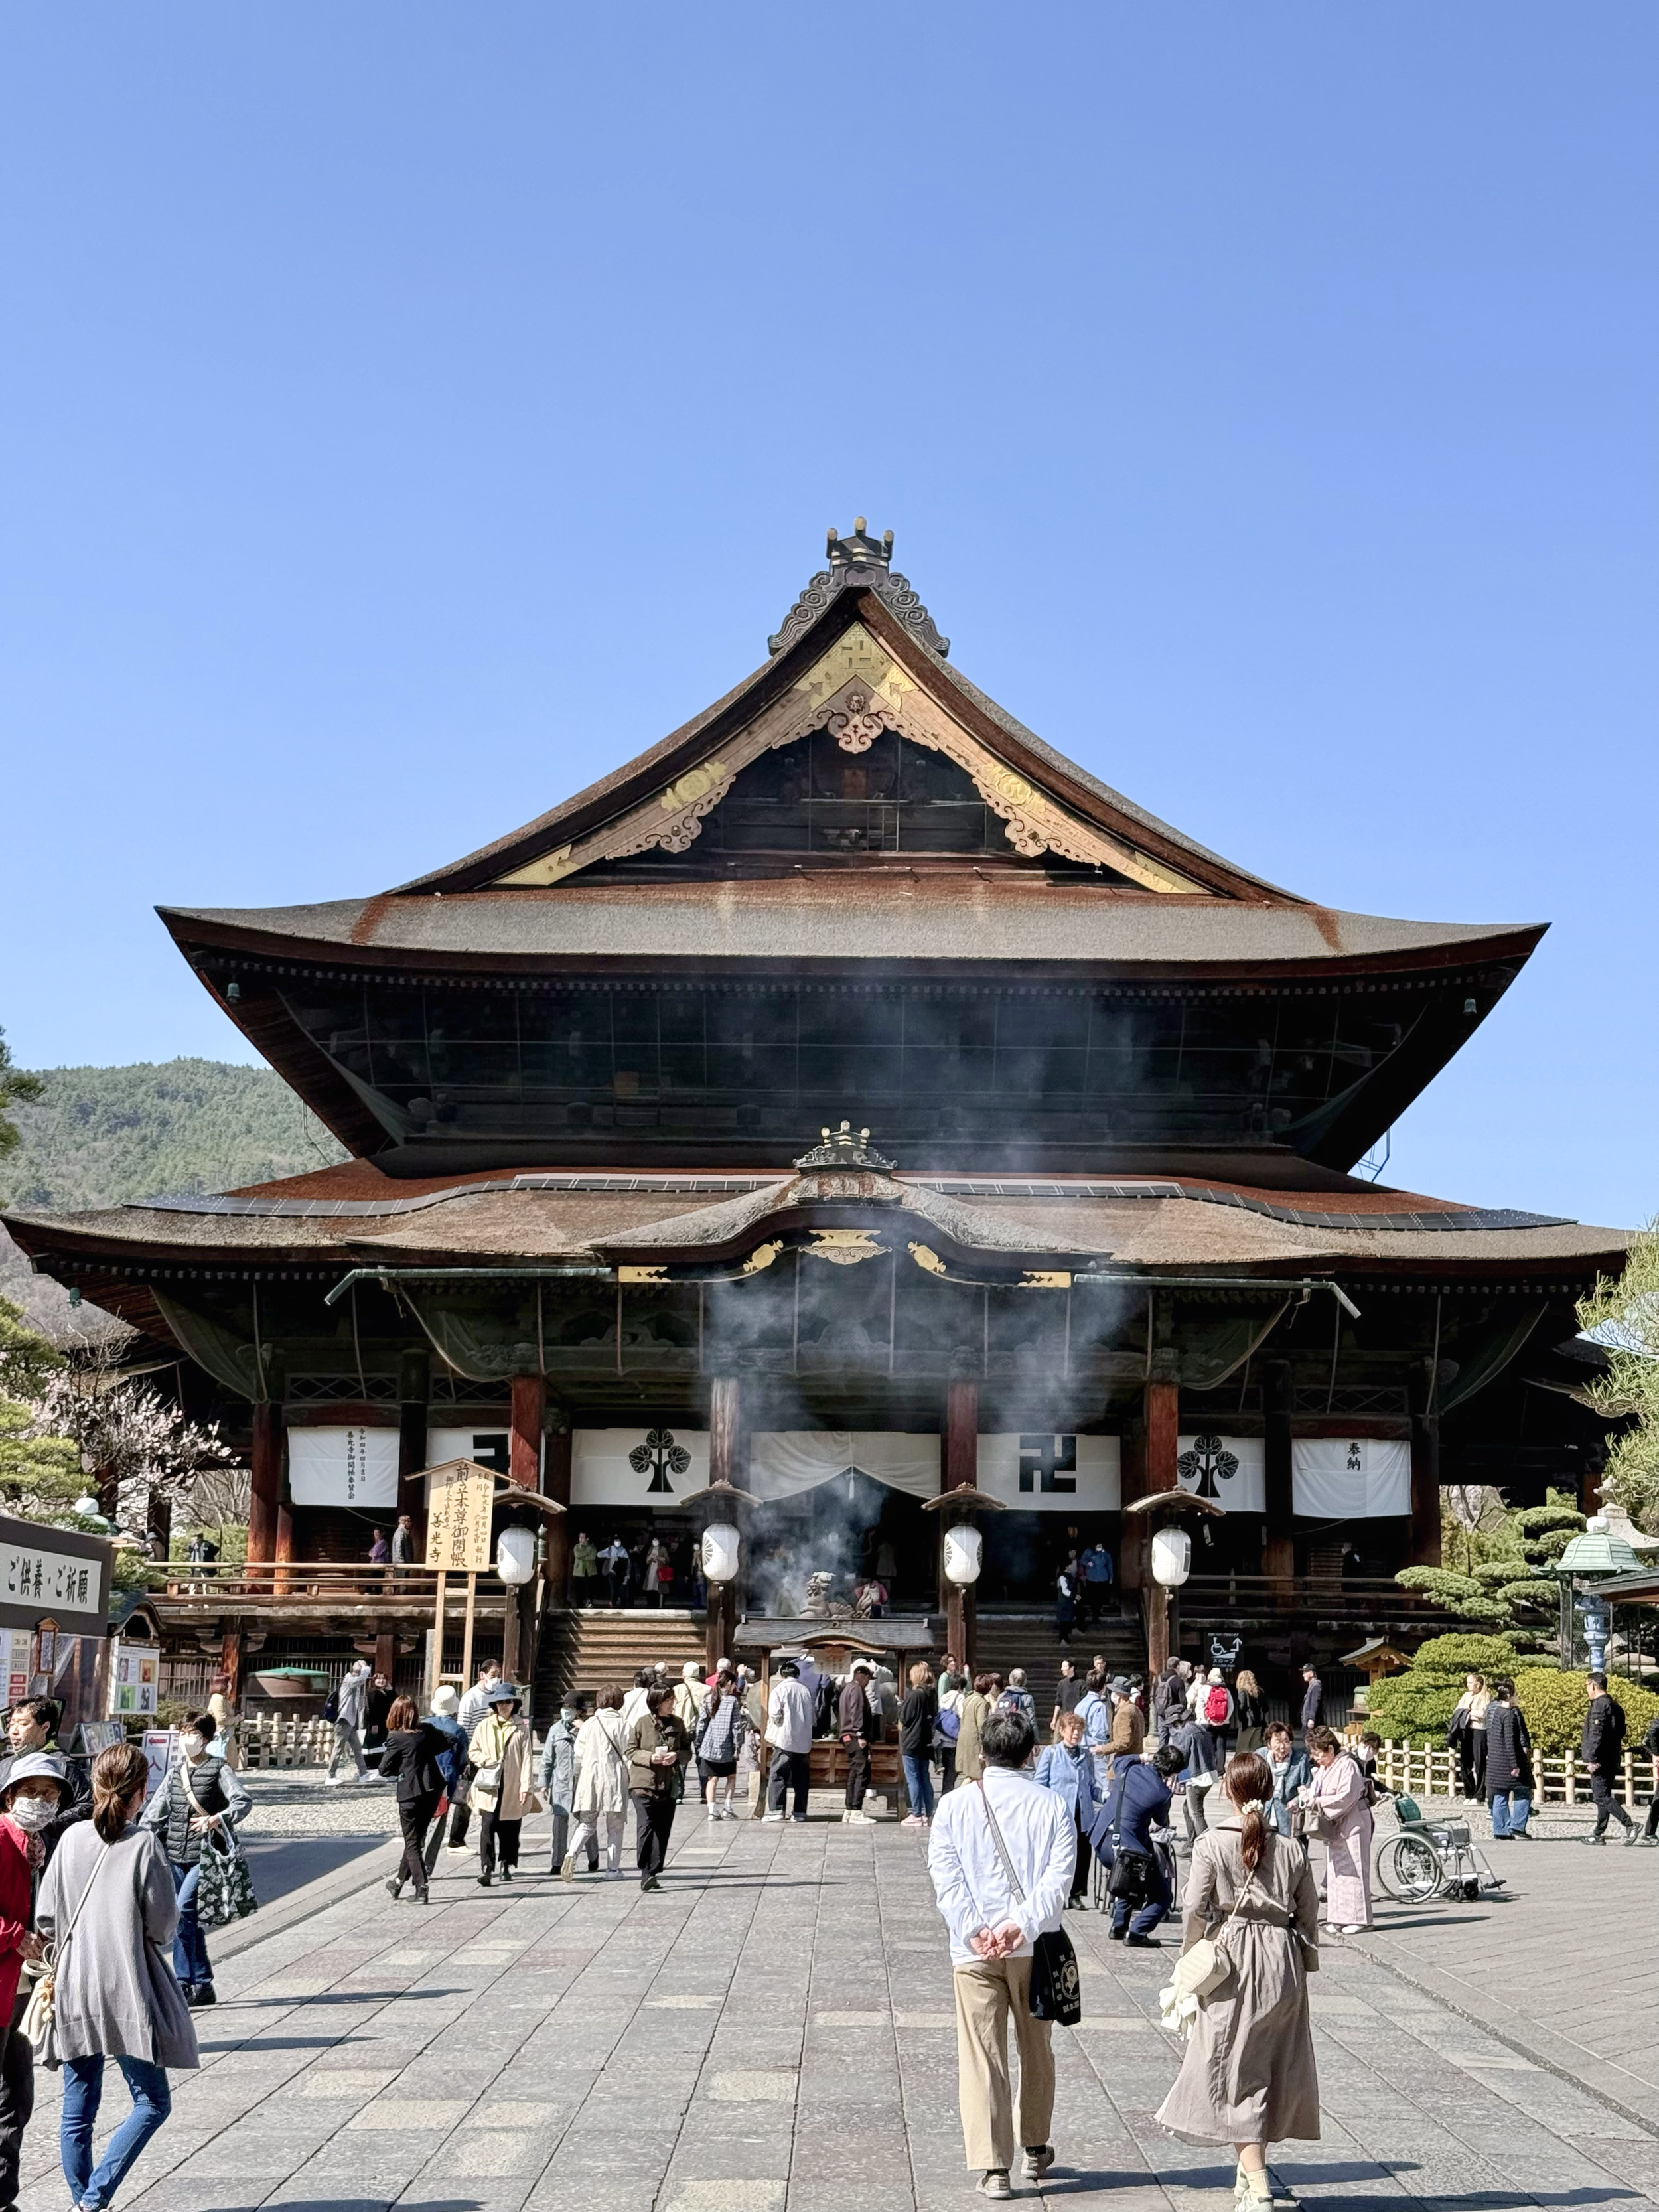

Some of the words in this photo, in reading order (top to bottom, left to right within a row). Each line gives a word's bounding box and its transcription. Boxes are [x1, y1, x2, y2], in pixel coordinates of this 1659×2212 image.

[1347, 1442, 1361, 1471] 奉納
[428, 1512, 444, 1563] 善光寺
[451, 1463, 470, 1568] 前立本尊御開帳
